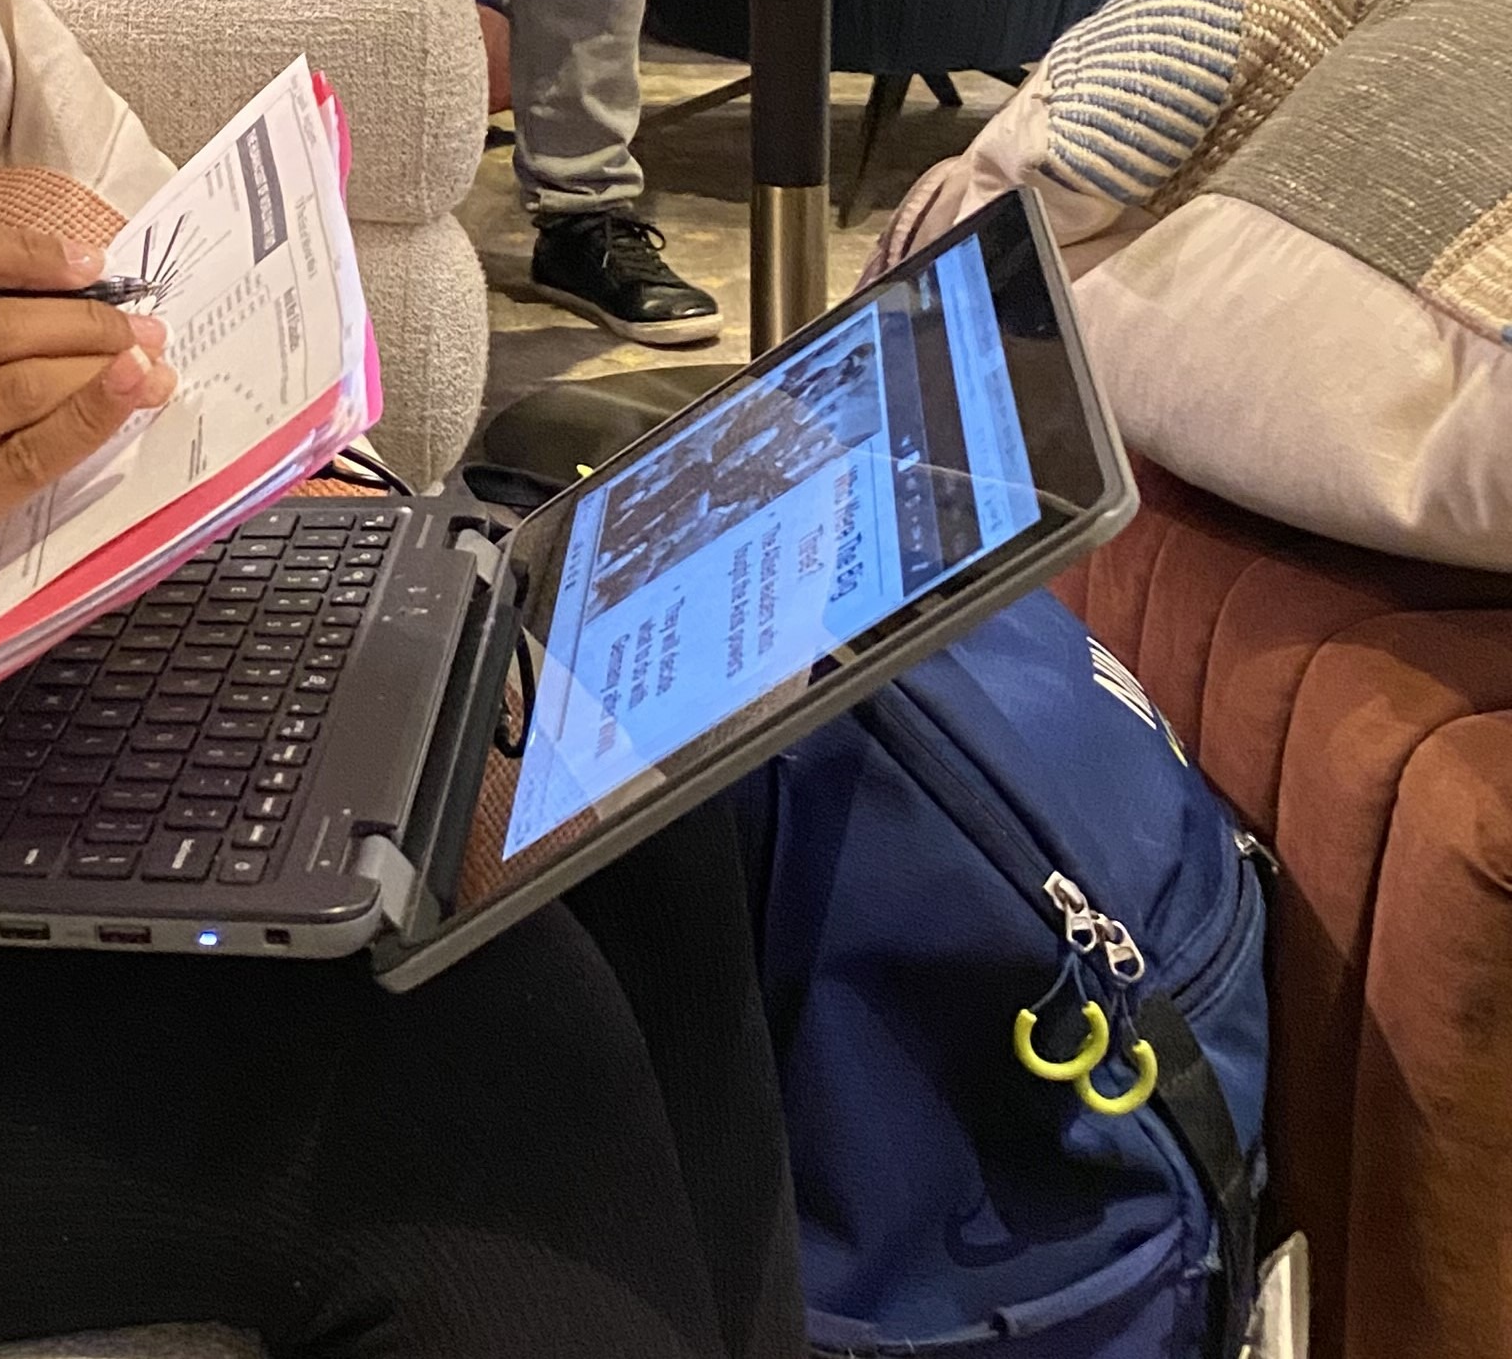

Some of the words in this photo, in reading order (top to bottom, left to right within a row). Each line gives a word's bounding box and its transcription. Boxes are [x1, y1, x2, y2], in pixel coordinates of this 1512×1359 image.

[762, 523, 779, 550] The
[836, 533, 861, 570] The
[798, 525, 822, 583] Three?
[732, 578, 749, 602] the
[831, 562, 862, 602] Big
[660, 597, 683, 634] They
[730, 598, 747, 630] Axis
[760, 577, 777, 626] leaders
[636, 616, 655, 649] what
[662, 627, 680, 653] will
[759, 622, 776, 655] who
[632, 659, 649, 681] do
[634, 646, 650, 663] to
[725, 627, 744, 680] powers
[656, 649, 677, 696] decide
[628, 678, 647, 709] with
